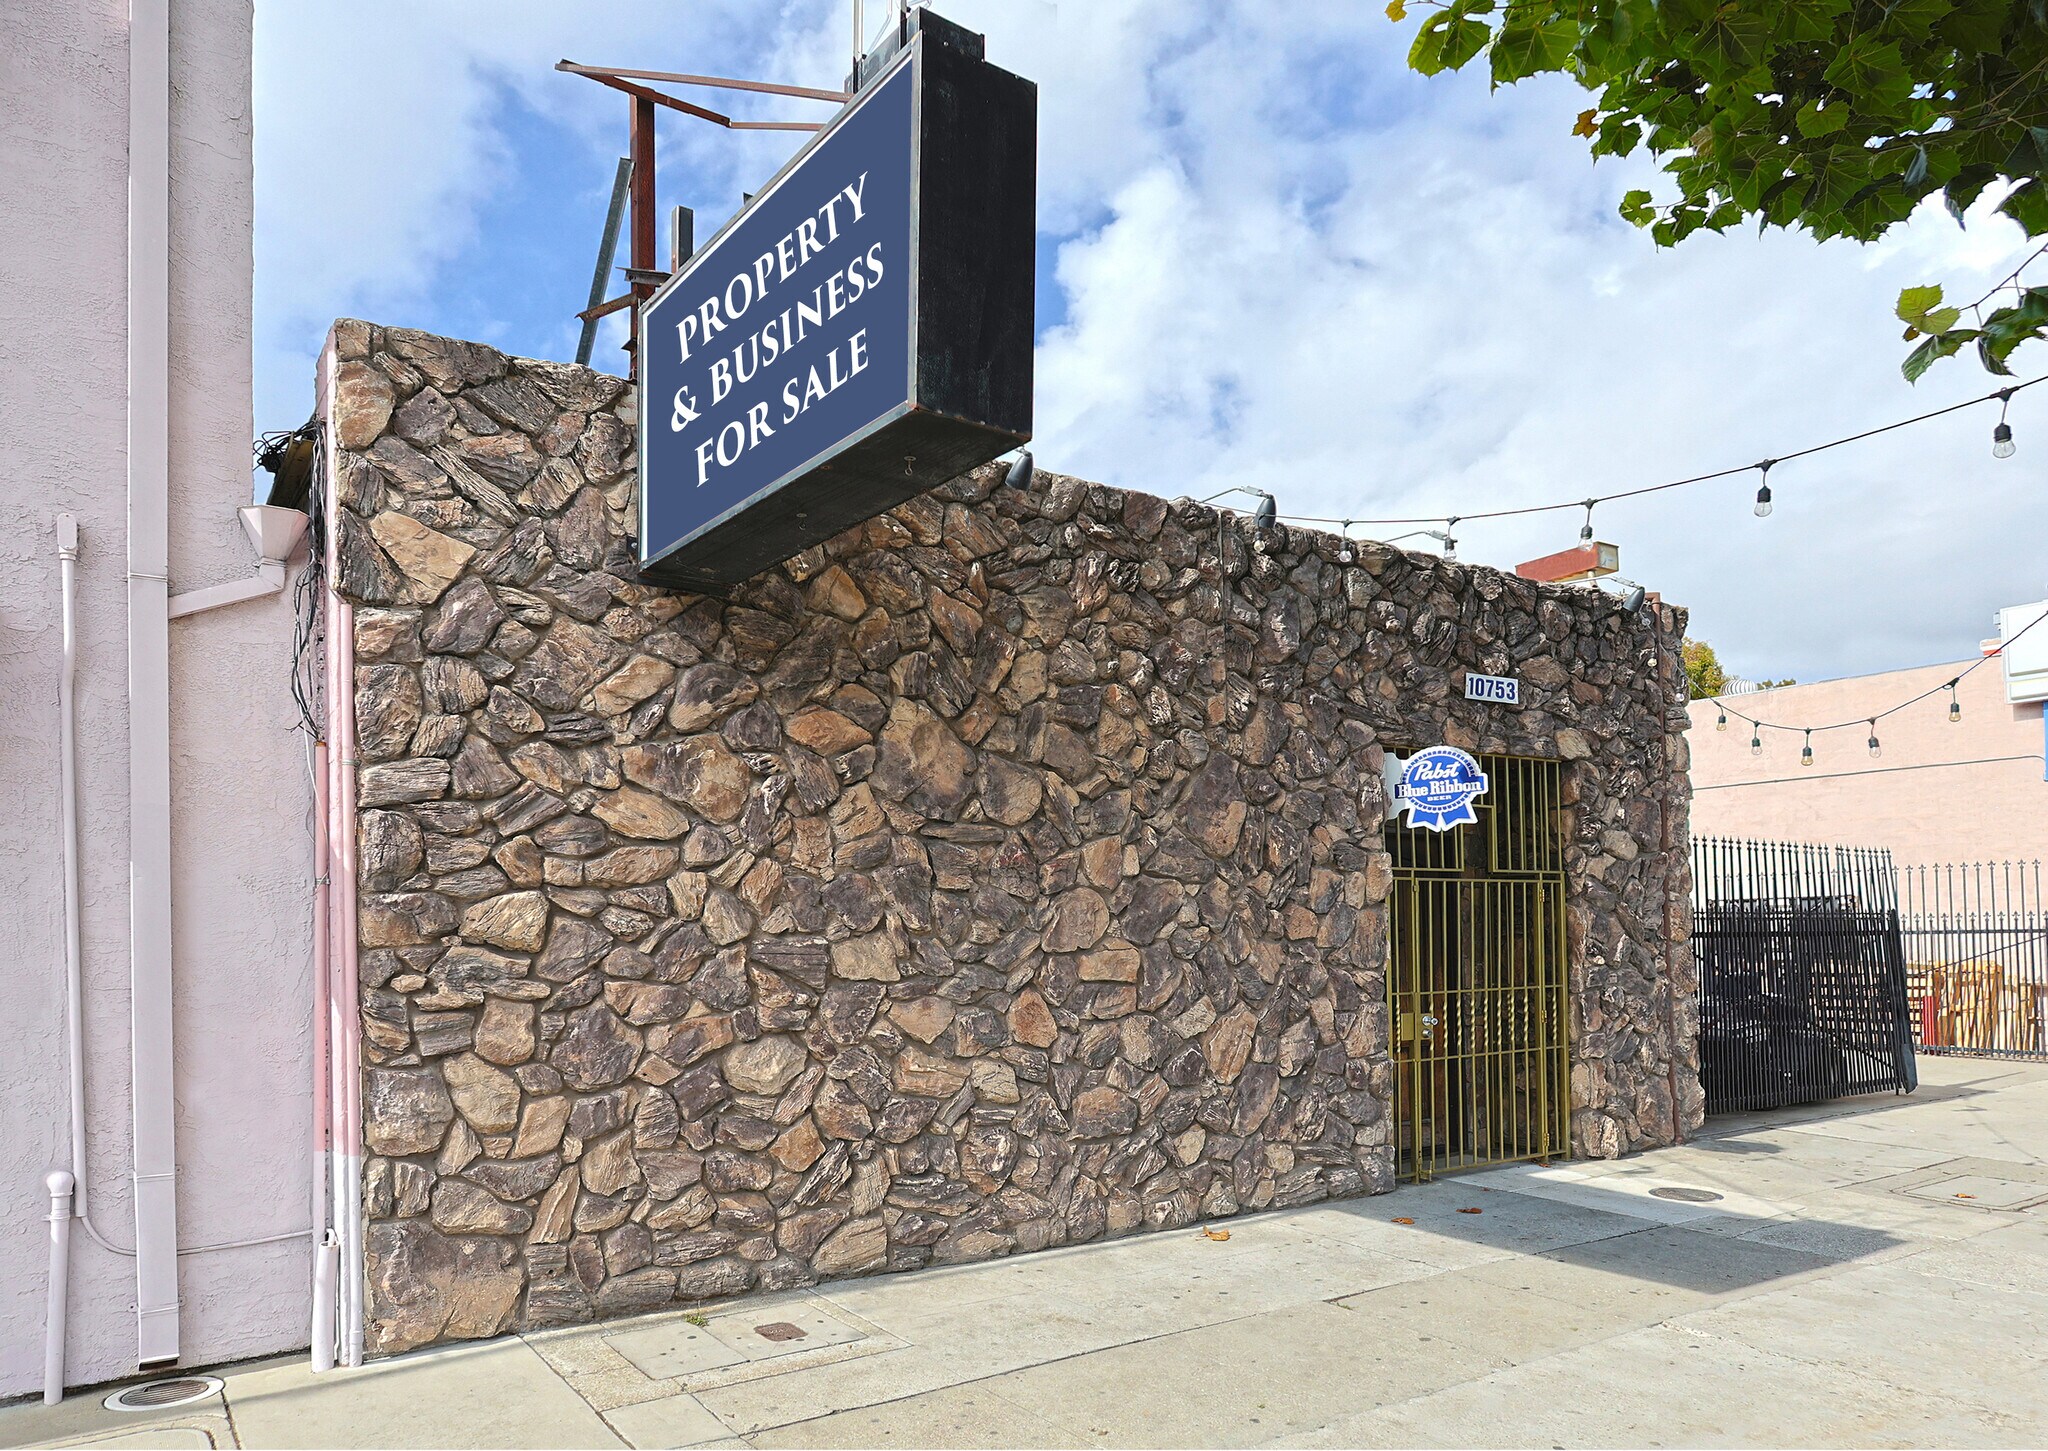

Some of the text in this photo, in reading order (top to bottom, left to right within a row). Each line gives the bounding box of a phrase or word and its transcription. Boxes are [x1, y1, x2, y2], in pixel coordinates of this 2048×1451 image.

[676, 171, 868, 364] PROPERTY
[671, 242, 884, 433] & BUSINESS
[694, 328, 868, 487] FOR SALE
[1468, 677, 1516, 700] 10753
[1397, 778, 1482, 797] Blue Ribbon
[1413, 760, 1461, 781] Pabst
